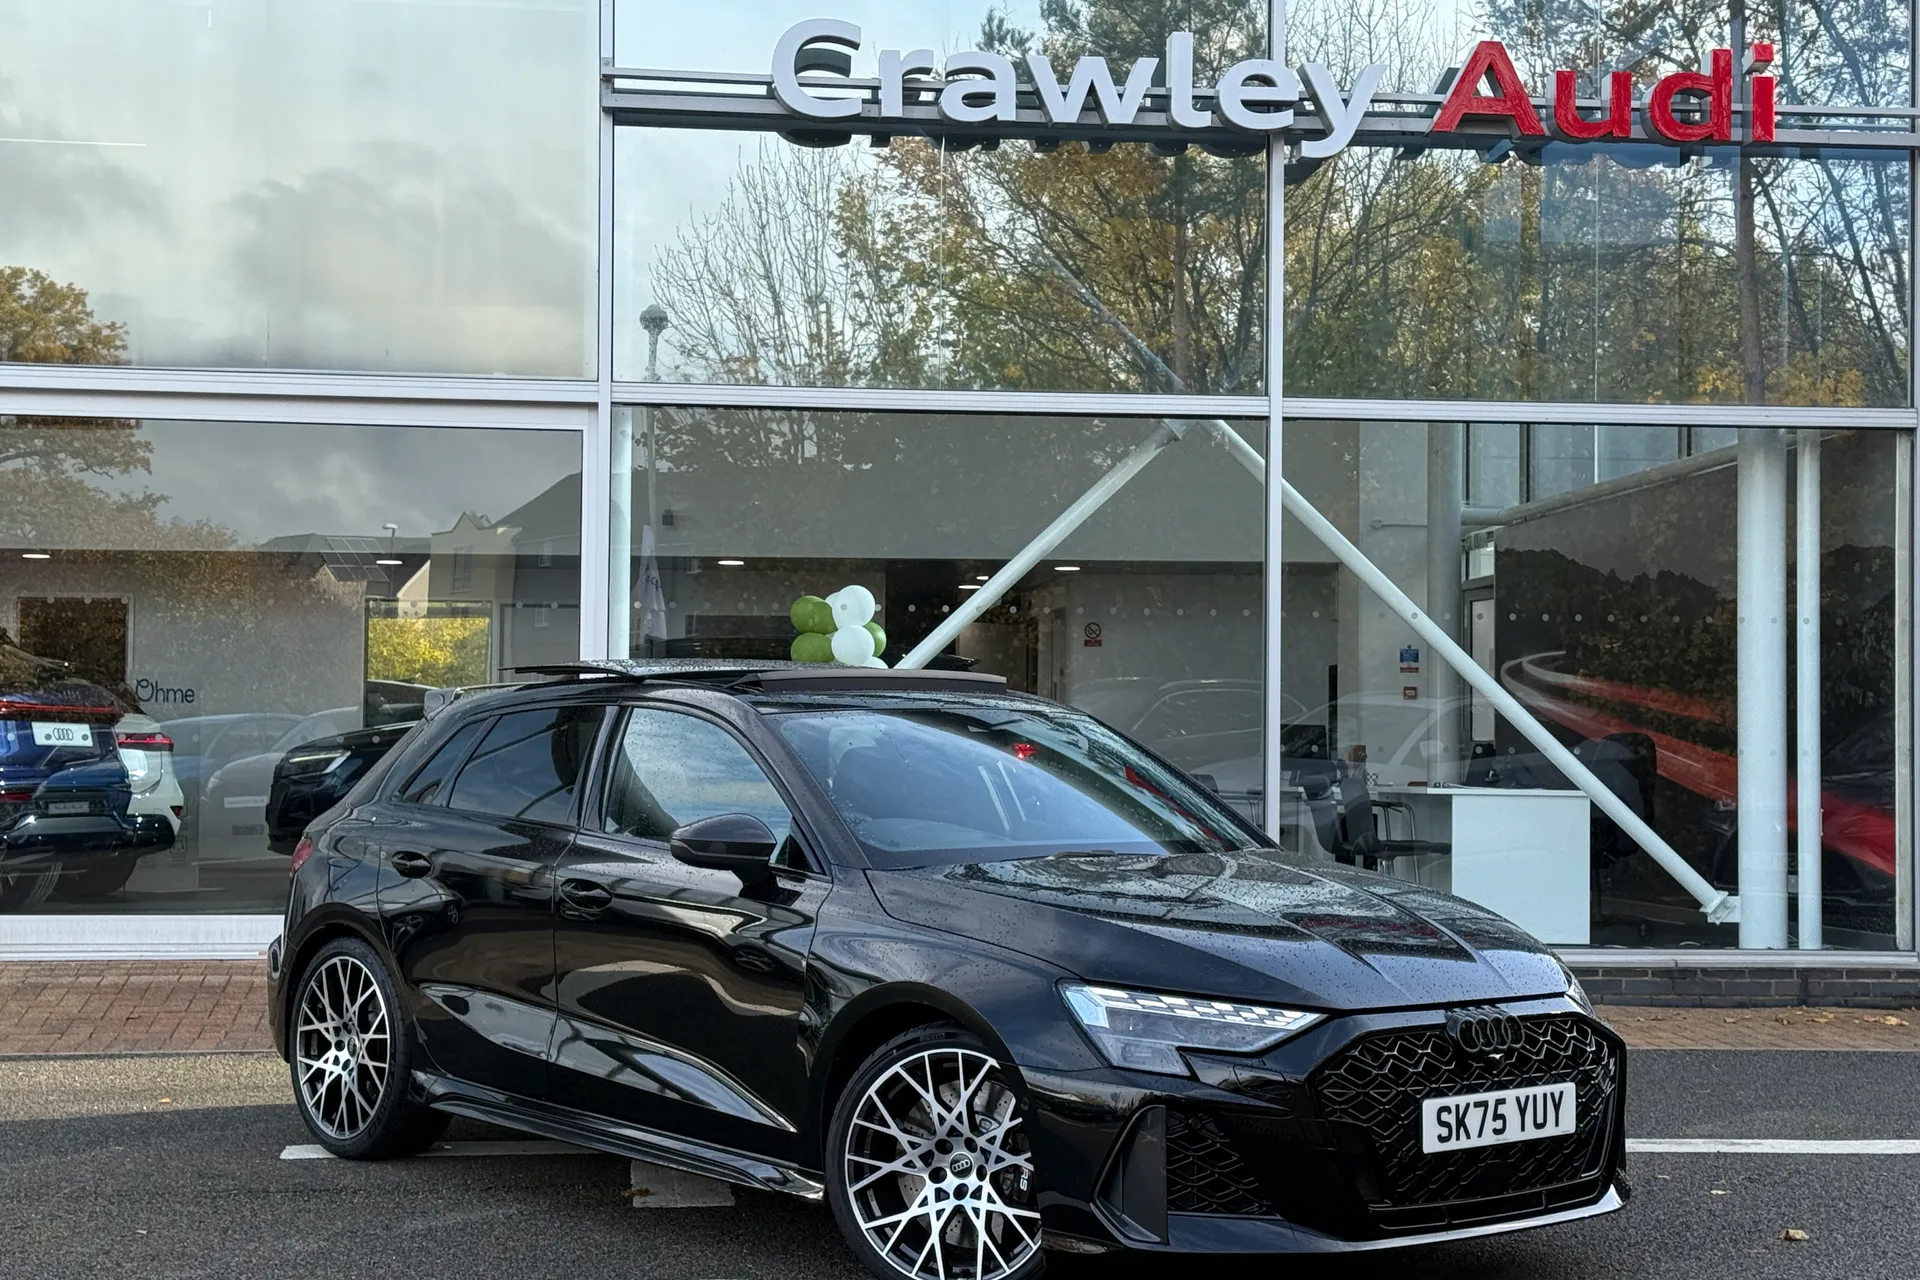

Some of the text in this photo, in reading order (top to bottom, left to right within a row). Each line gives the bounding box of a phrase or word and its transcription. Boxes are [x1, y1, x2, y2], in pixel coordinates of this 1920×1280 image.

[772, 18, 1775, 158] Crawley Audi
[136, 678, 195, 703] Ohme
[1436, 1090, 1564, 1144] SK75 YUY
[1020, 1166, 1029, 1191] RS
